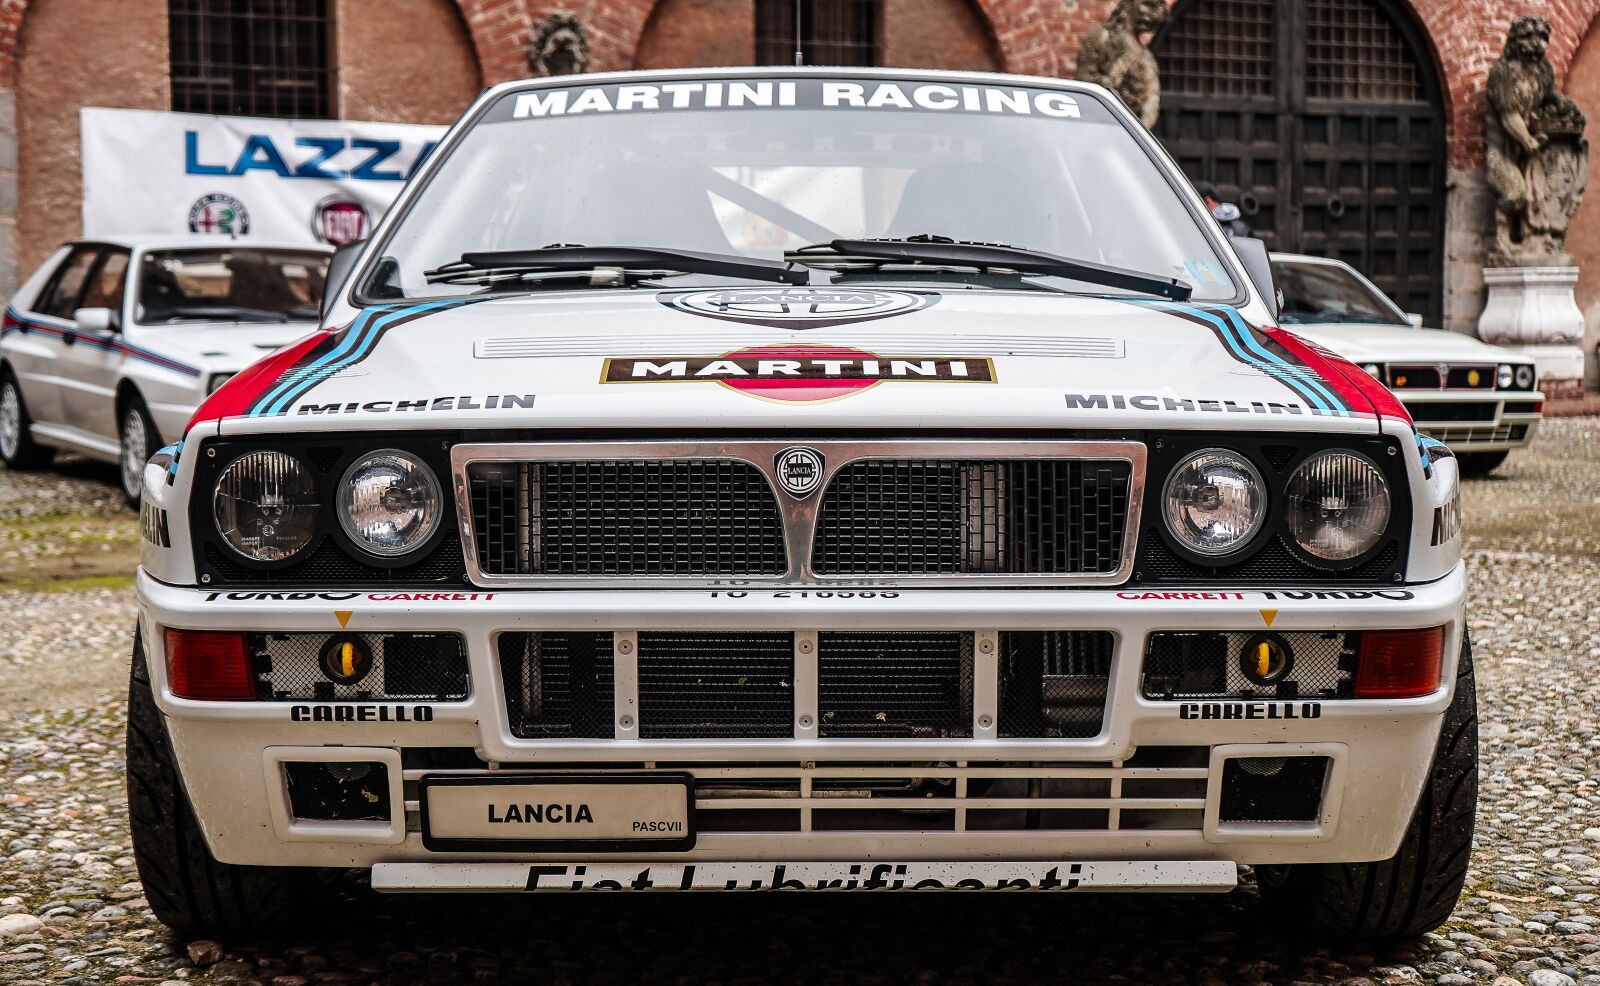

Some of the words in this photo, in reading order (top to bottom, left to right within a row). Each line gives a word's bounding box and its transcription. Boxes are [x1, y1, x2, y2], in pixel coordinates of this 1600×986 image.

[513, 81, 796, 118] MARTINI
[823, 81, 1081, 119] RACING
[632, 360, 968, 377] MARTINI
[298, 394, 536, 416] MICHELIN
[1064, 393, 1303, 415] MICHELIN
[788, 466, 811, 475] LANCIA
[290, 705, 434, 722] CARELLO
[1180, 703, 1322, 720] CARELLO
[488, 803, 594, 824] LANCIA
[632, 821, 682, 832] PASCVII
